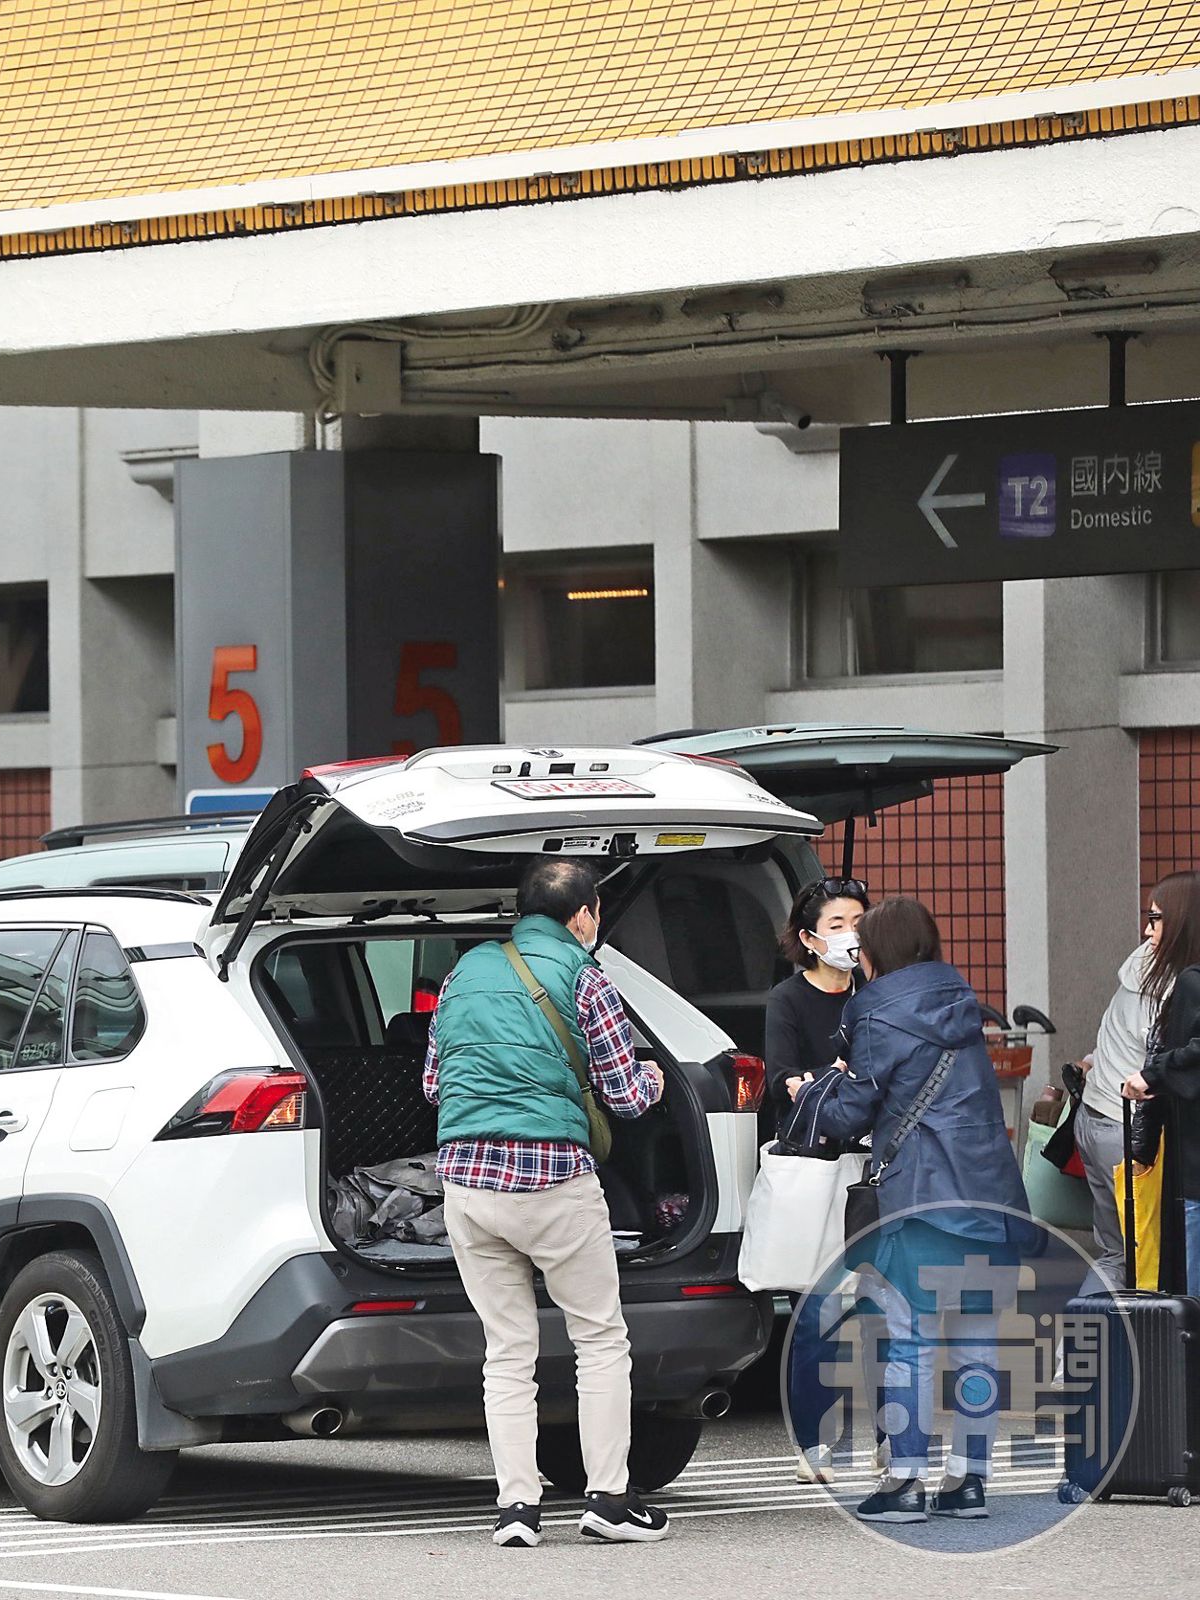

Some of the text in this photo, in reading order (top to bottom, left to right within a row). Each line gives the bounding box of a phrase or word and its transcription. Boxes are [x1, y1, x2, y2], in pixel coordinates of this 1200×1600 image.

[1007, 474, 1050, 517] T2
[1071, 451, 1163, 498] 國內線
[1070, 506, 1153, 530] Domestic
[207, 644, 263, 784] 5
[392, 641, 464, 757] 5
